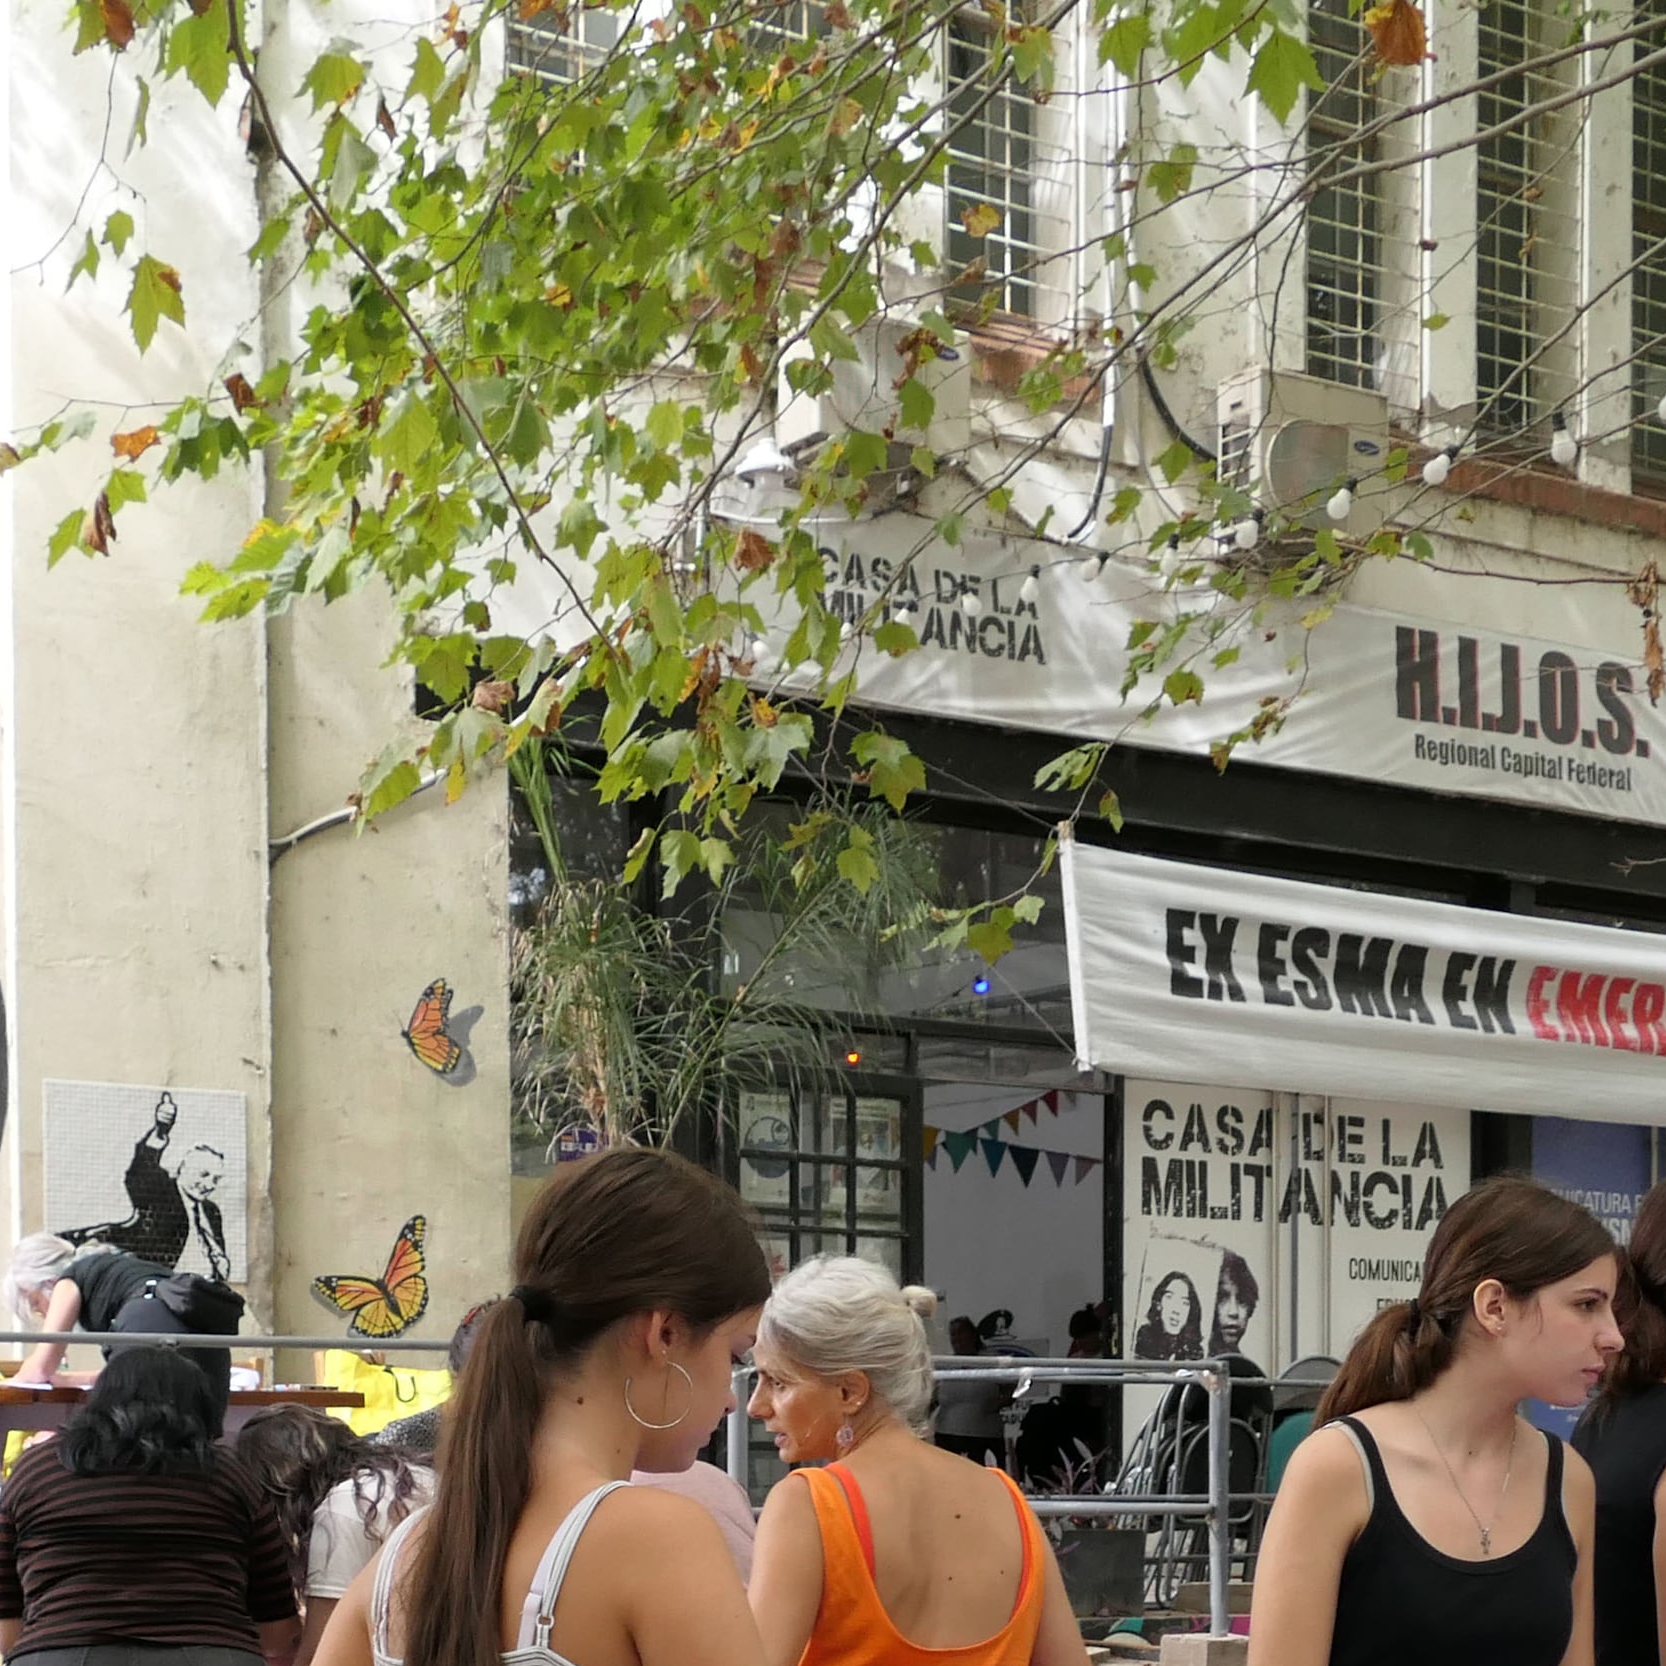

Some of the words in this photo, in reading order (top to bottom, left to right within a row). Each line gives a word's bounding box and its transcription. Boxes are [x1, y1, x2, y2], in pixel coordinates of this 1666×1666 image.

[818, 547, 921, 598] CASA
[1395, 625, 1651, 759] H.I.J.O.S.
[1414, 733, 1496, 769] Regional
[1500, 746, 1563, 780] Capital
[1567, 758, 1632, 792] Federal
[1164, 906, 1247, 1004] EX
[1256, 921, 1436, 1027] ESMA
[1442, 950, 1518, 1036] EN
[1141, 1098, 1273, 1158] CASA
[1302, 1111, 1366, 1165] DE
[1381, 1117, 1445, 1170] LA
[1141, 1155, 1450, 1231] MILITANCIA
